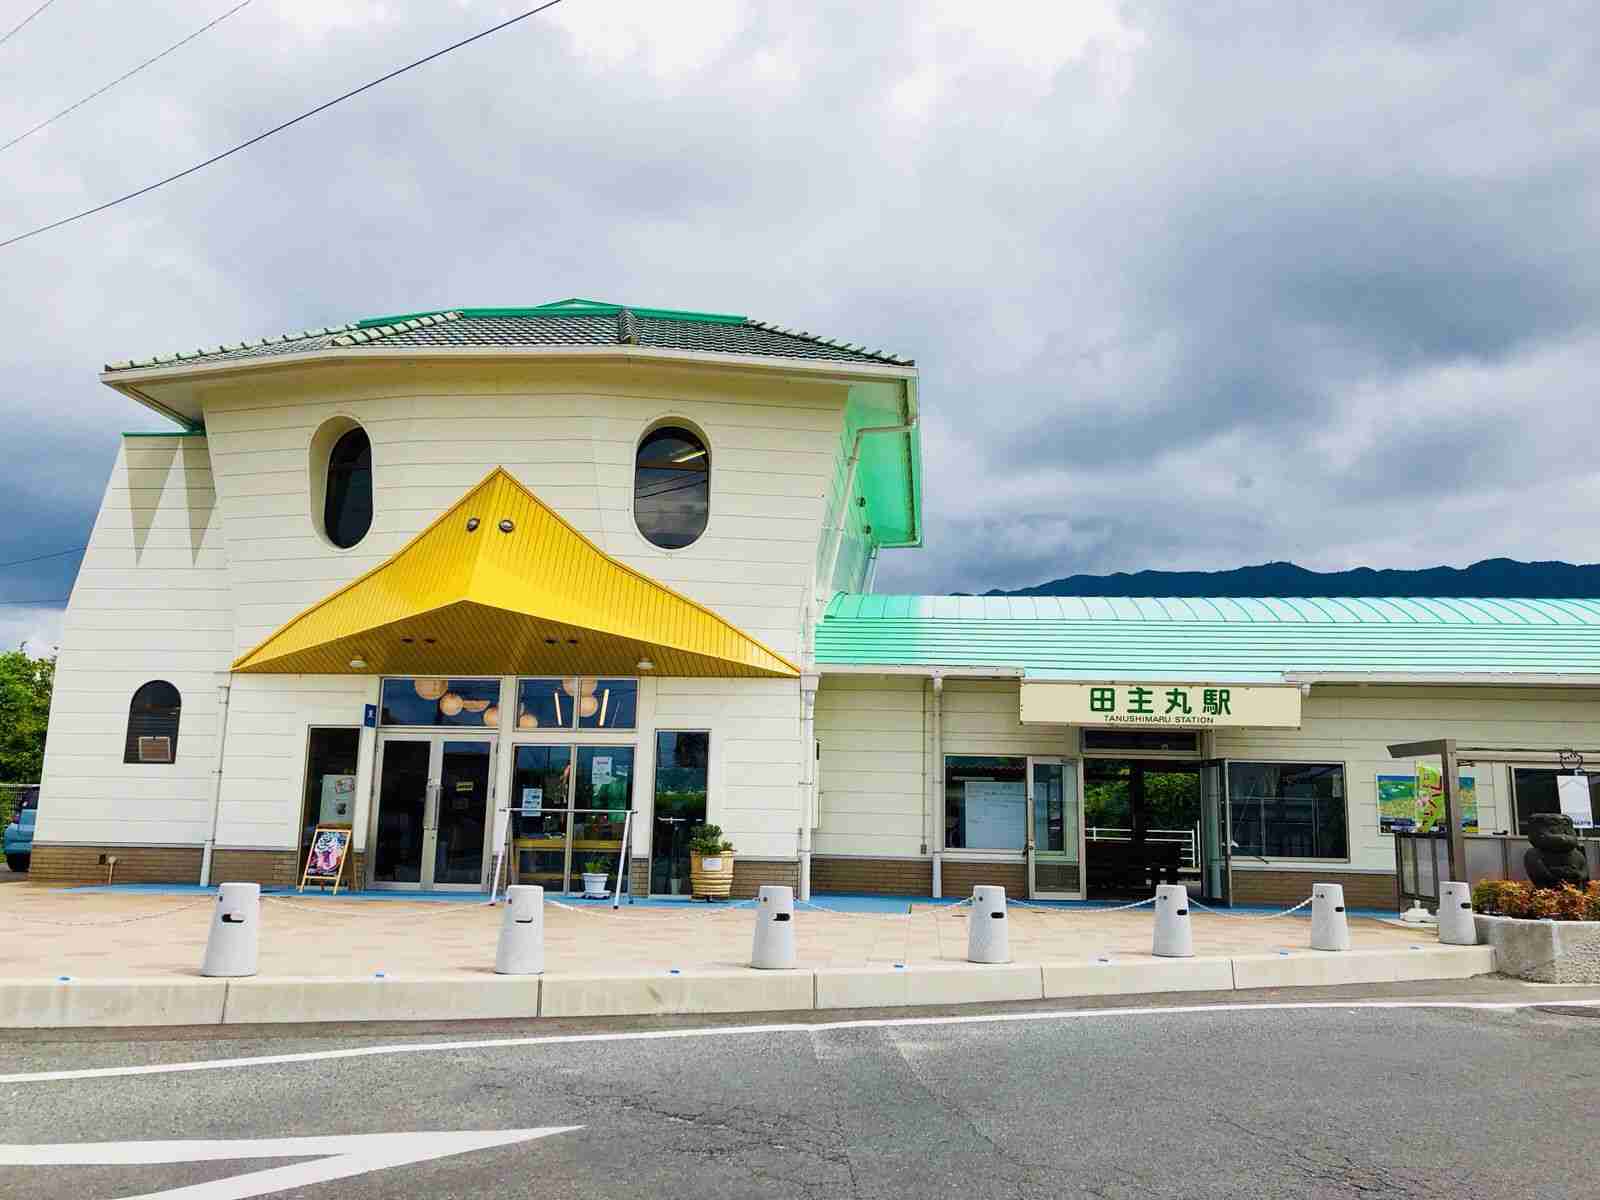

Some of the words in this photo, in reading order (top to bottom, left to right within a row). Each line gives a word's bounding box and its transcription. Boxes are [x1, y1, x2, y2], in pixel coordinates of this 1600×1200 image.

[1090, 687, 1232, 715] 田主丸駅
[1104, 714, 1171, 724] TANUSHIMARU
[1175, 715, 1214, 724] STATION
